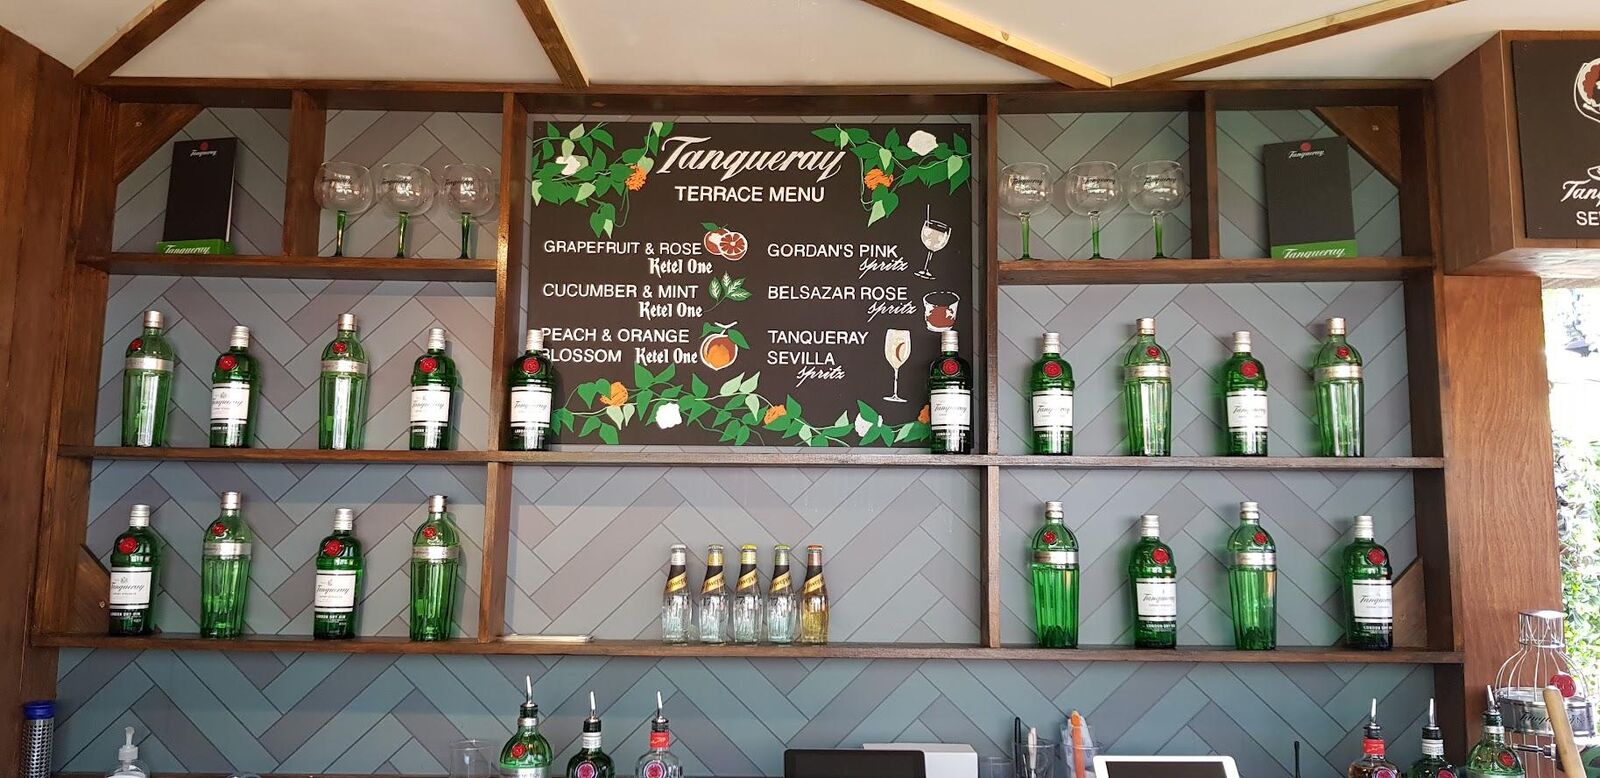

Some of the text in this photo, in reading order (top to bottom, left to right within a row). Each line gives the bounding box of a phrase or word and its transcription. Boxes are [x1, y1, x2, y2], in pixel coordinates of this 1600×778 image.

[655, 135, 846, 183] Tanqueray
[1288, 150, 1325, 159] Tanqueray
[674, 186, 825, 203] TERRACE MENU
[164, 244, 211, 254] Tanqueray
[544, 240, 703, 256] GRAPEFRUIT & ROSE
[767, 243, 899, 259] GORDAN'S PINK
[1283, 248, 1345, 259] Tanqueray
[647, 257, 714, 279] Ketel One
[858, 257, 910, 280] spritz
[542, 283, 699, 299] CUCUMBER & MINT
[767, 285, 908, 301] BELSAZAR ROSE
[638, 301, 703, 321] Ketel One
[867, 300, 917, 323] spritz
[541, 327, 690, 343] PEACH & ORANGE
[767, 329, 870, 345] TANQUERAY
[542, 347, 698, 367] BLOSSOM Ketel One
[766, 350, 836, 366] SEVILLA
[795, 364, 846, 388] spritz
